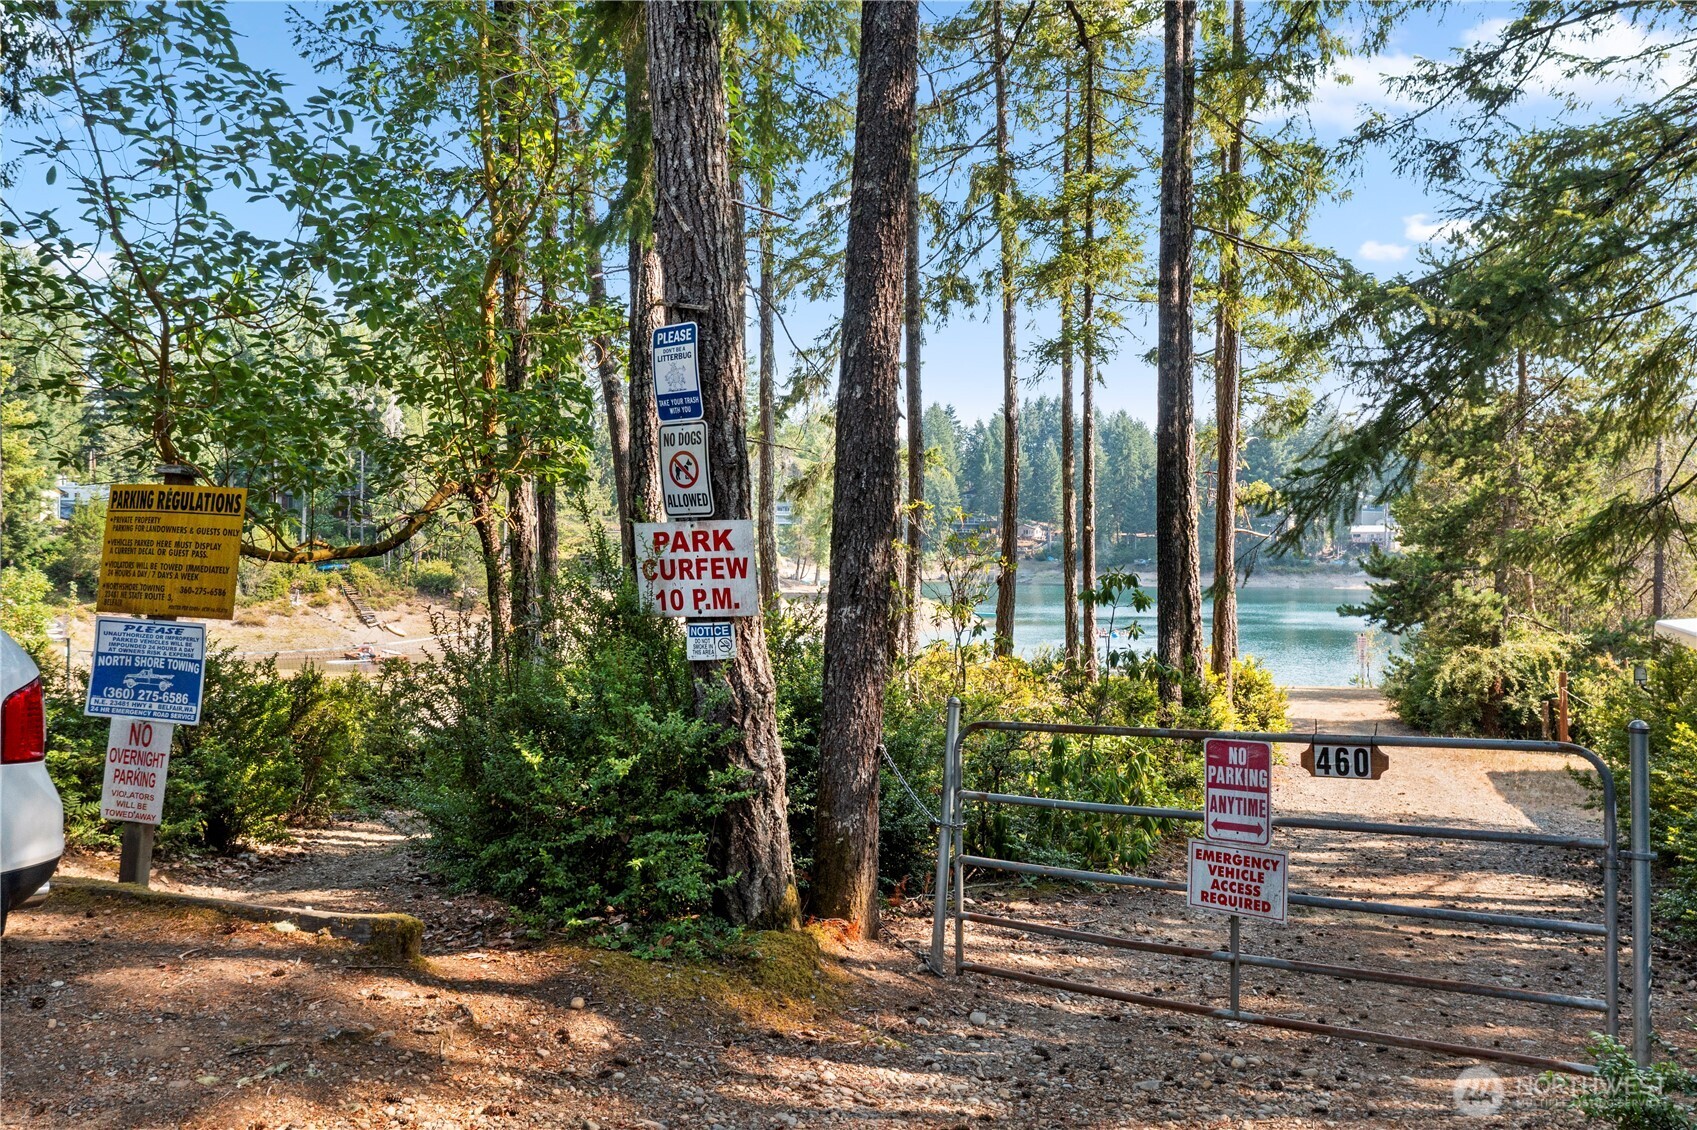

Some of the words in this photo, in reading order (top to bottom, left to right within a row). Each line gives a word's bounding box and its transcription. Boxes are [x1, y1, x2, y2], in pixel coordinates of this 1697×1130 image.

[657, 328, 692, 345] PLEASE
[657, 352, 692, 362] LITTERBUG
[671, 398, 684, 406] YOUR
[684, 396, 699, 404] TRASH
[663, 432, 676, 447] NO
[678, 431, 702, 446] DOGS
[111, 490, 154, 509] PARKING
[157, 490, 242, 513] REGULATIONS
[667, 493, 708, 508] ALLOWED
[135, 516, 161, 524] PROPERTY
[113, 524, 134, 532] PARKING
[146, 526, 187, 534] LANDOWNERS
[196, 528, 220, 536] GUESTS
[110, 538, 132, 546] VEHICLES
[135, 539, 154, 547] PARKED
[156, 540, 172, 548] HERE
[174, 541, 192, 549] MUST
[195, 542, 222, 550] DISPLAY
[653, 529, 735, 553] PARK
[115, 547, 136, 555] CURRENT
[168, 549, 189, 557] GUEST
[192, 550, 208, 558] PASS.
[108, 561, 135, 569] VIOLATORS
[160, 563, 183, 571] TOWED
[186, 564, 230, 574] IMMEDIATELY
[158, 571, 173, 579] DAYS
[642, 557, 749, 580] CURFEW
[128, 591, 143, 600] STATE
[144, 592, 165, 601] ROUTE
[140, 584, 165, 592] TOWING
[180, 586, 227, 596] 360-275-6586
[656, 589, 684, 611] 10
[693, 588, 740, 610] P.M.
[104, 631, 153, 639] UNAUTHORIZED
[124, 624, 184, 635] PLEASE
[691, 626, 729, 636] NOTICE
[98, 655, 132, 667] NORTH
[134, 656, 165, 668] SHORE
[167, 658, 200, 674] TOWING
[103, 687, 134, 700] (360)
[138, 690, 189, 704] 275-6586
[112, 708, 152, 716] EMERGENCY
[170, 712, 195, 720] SERVICE
[129, 723, 152, 747] NO
[109, 748, 166, 768] OVERNIGHT
[1228, 746, 1247, 765] NO
[1316, 746, 1369, 778] 460
[113, 769, 156, 788] PARKING
[1208, 766, 1268, 788] PARKING
[111, 789, 155, 801] VIOLATORS
[116, 800, 135, 809] WILL
[137, 802, 147, 810] BE
[1209, 794, 1266, 818] ANYTIME
[104, 809, 134, 818] TOWED
[135, 812, 156, 821] AWAY
[1195, 848, 1280, 872] EMERGENCY
[1208, 864, 1265, 884] VEHICLE
[1210, 878, 1261, 896] ACCESS
[1200, 890, 1271, 913] REQUIRED
